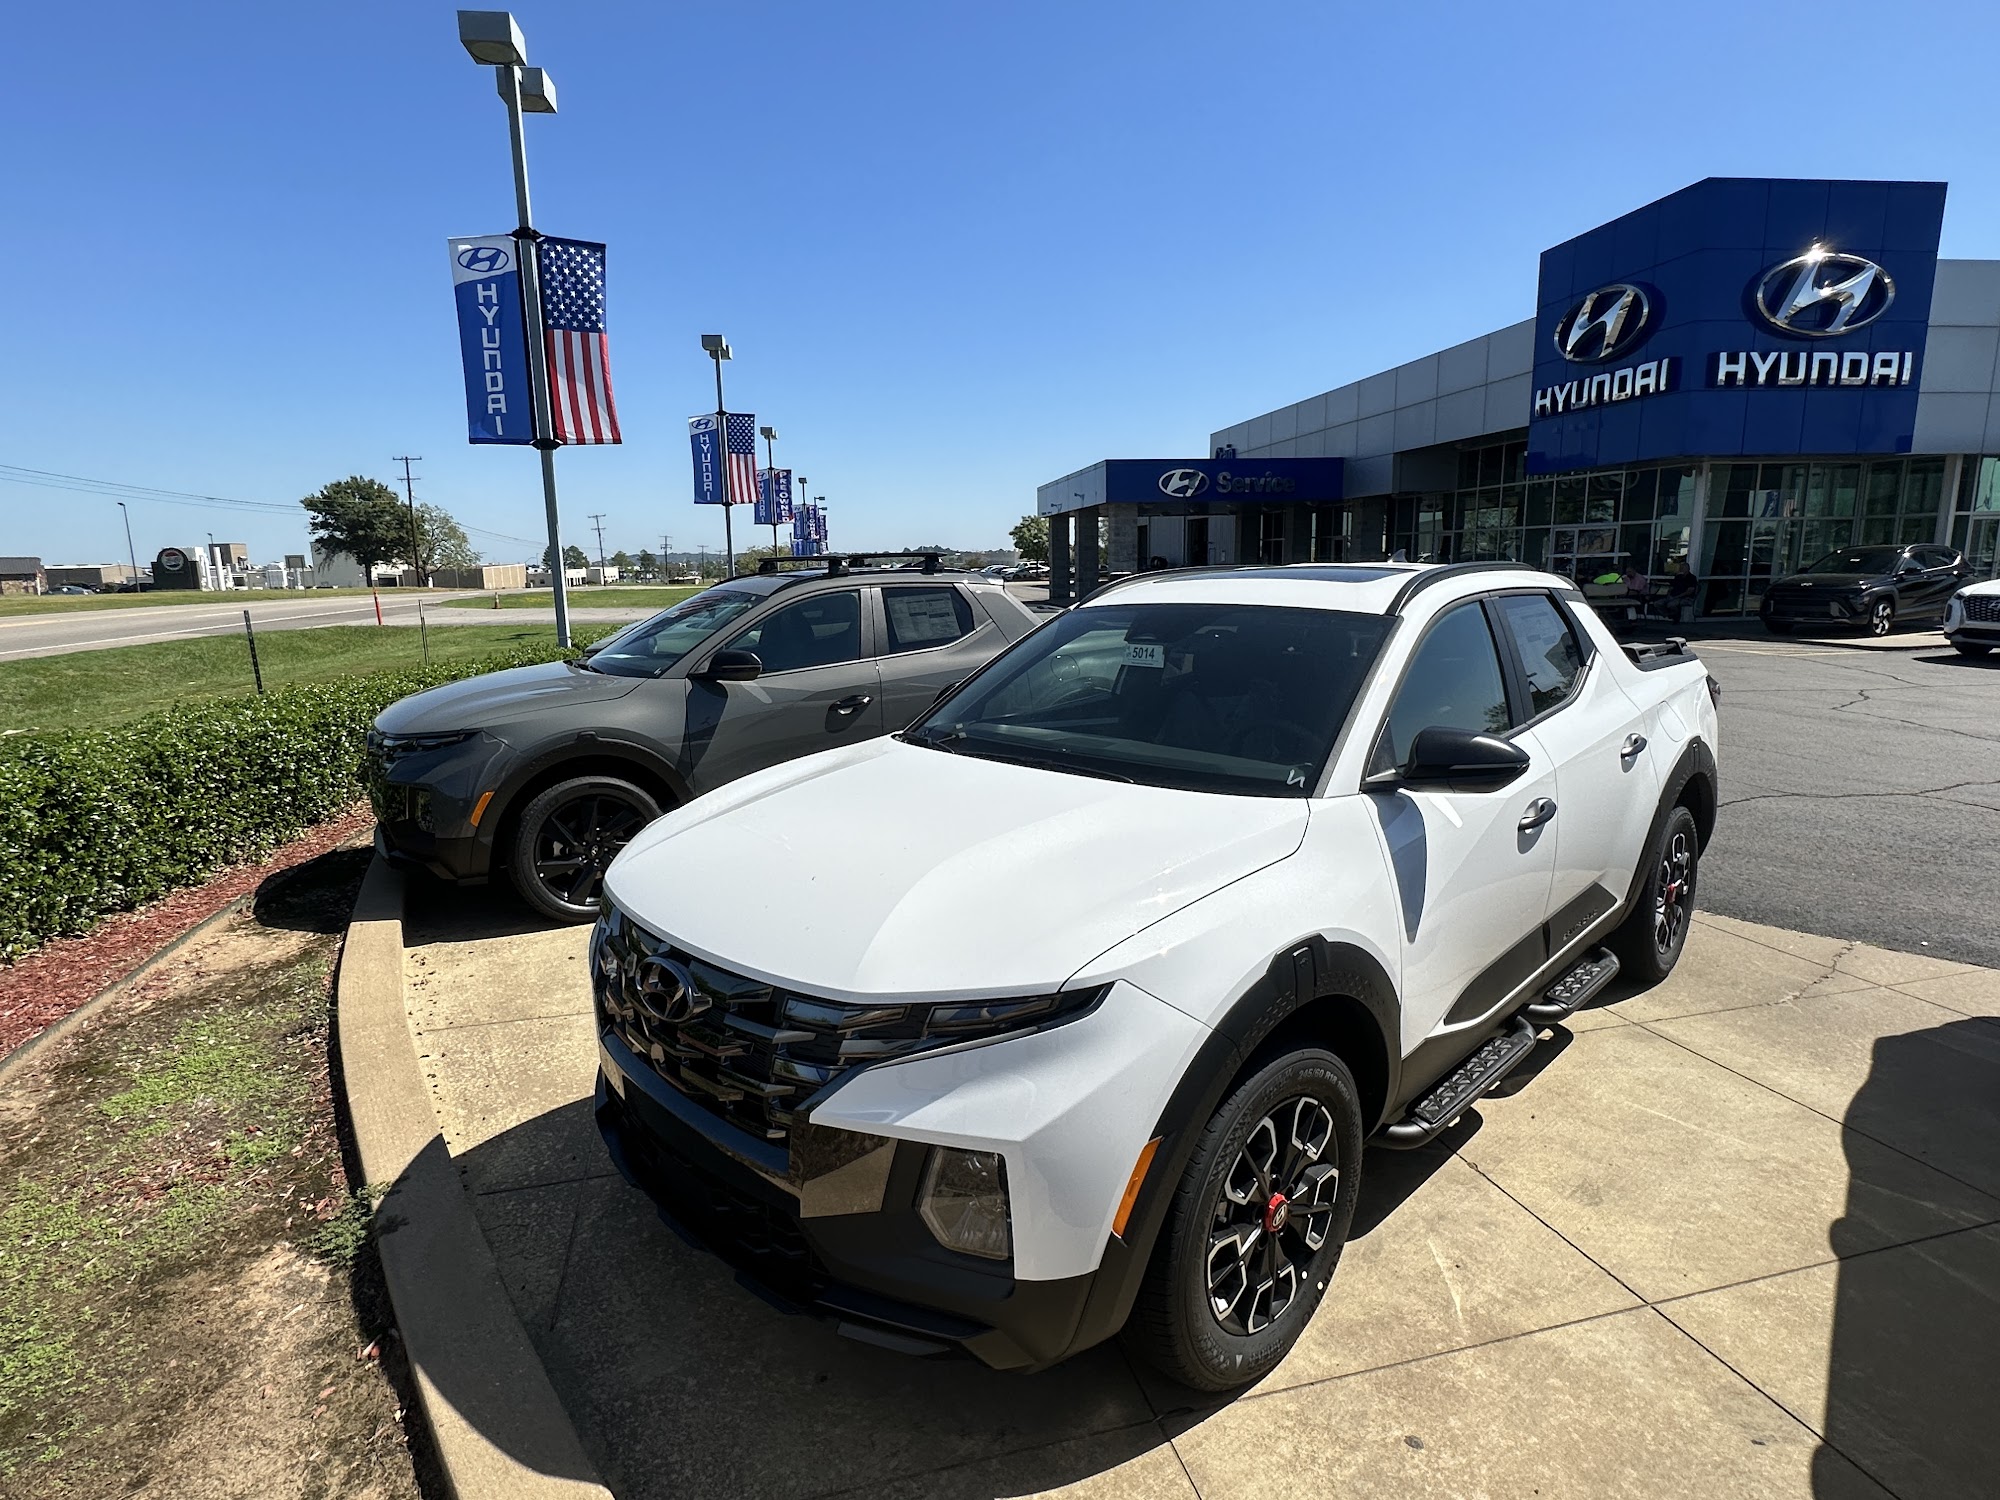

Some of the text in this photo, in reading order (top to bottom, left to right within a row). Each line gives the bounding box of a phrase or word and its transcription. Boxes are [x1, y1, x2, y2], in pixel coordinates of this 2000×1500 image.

[477, 283, 507, 435] HYUNDAI
[1718, 351, 1912, 386] HYUNDAI
[1535, 358, 1669, 417] HYUNDAI
[700, 434, 713, 501] HYUNDAI
[1216, 471, 1296, 493] Service
[1132, 647, 1155, 660] 5014
[1298, 1068, 1325, 1080] 245/60
[1324, 1070, 1338, 1085] R18
